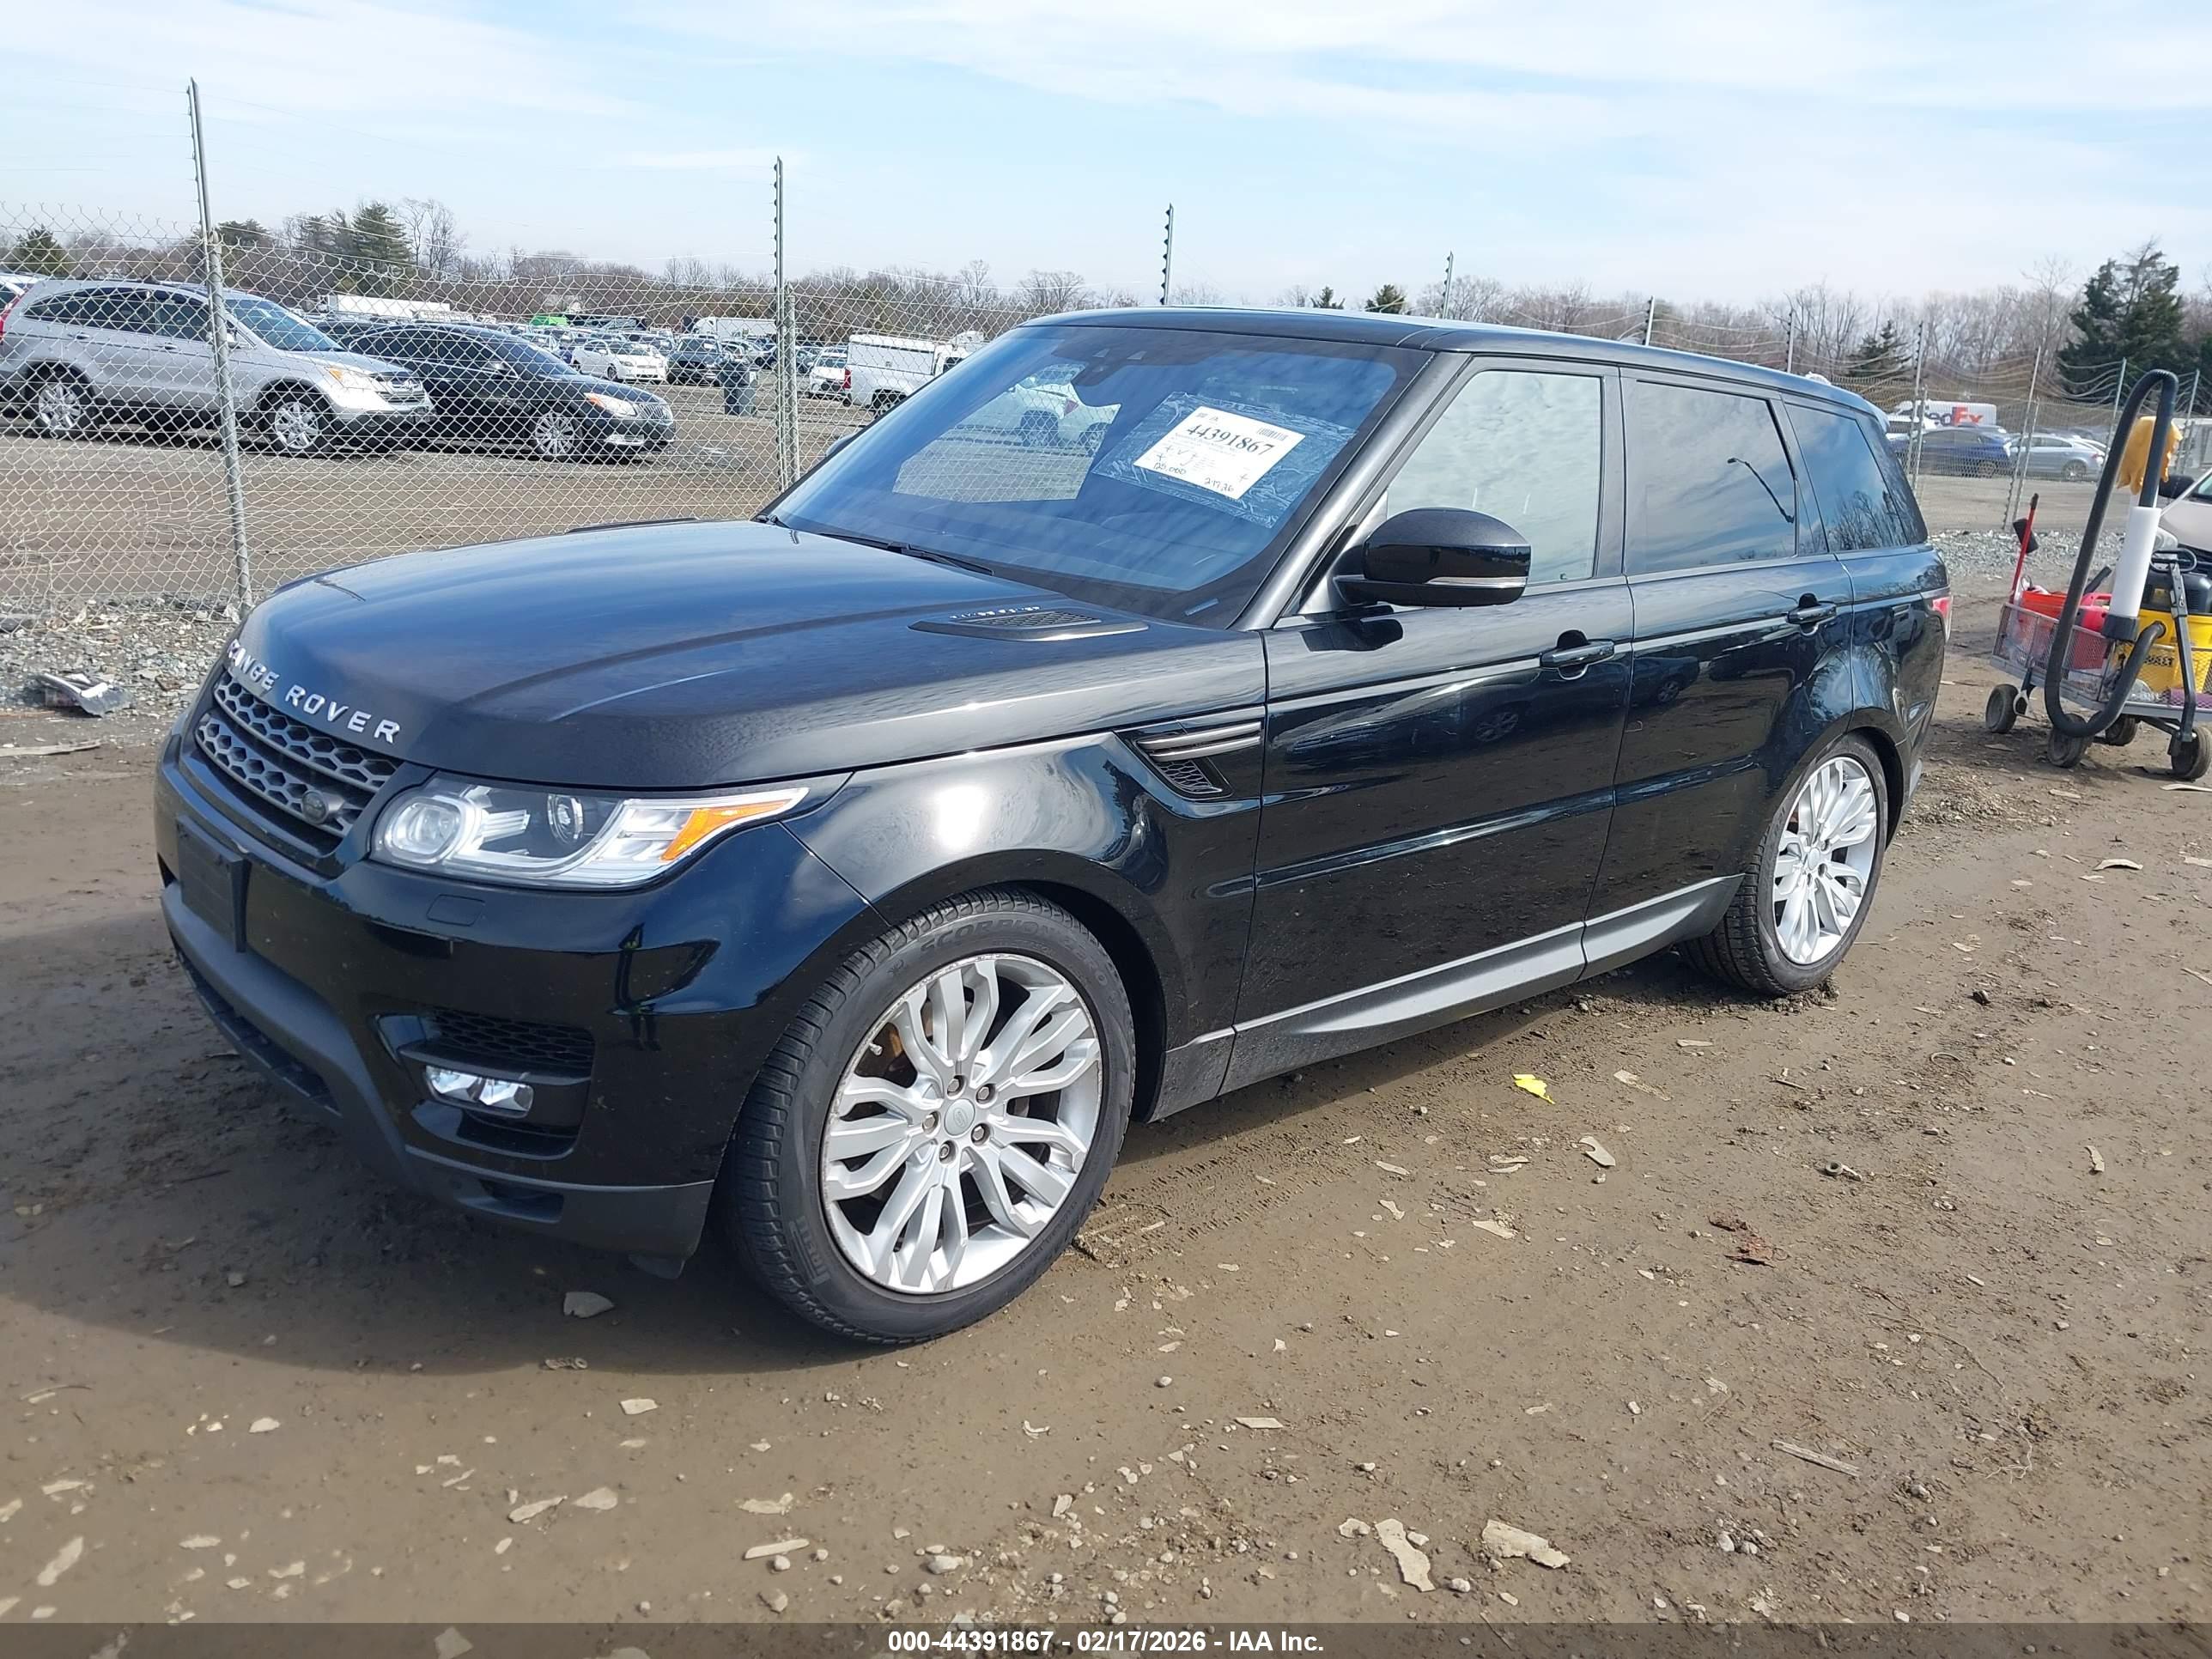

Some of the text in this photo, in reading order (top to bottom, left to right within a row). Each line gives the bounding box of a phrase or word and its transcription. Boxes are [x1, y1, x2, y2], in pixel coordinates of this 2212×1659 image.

[1187, 424, 1275, 456] 44391867
[227, 639, 401, 744] RANGE ROVER
